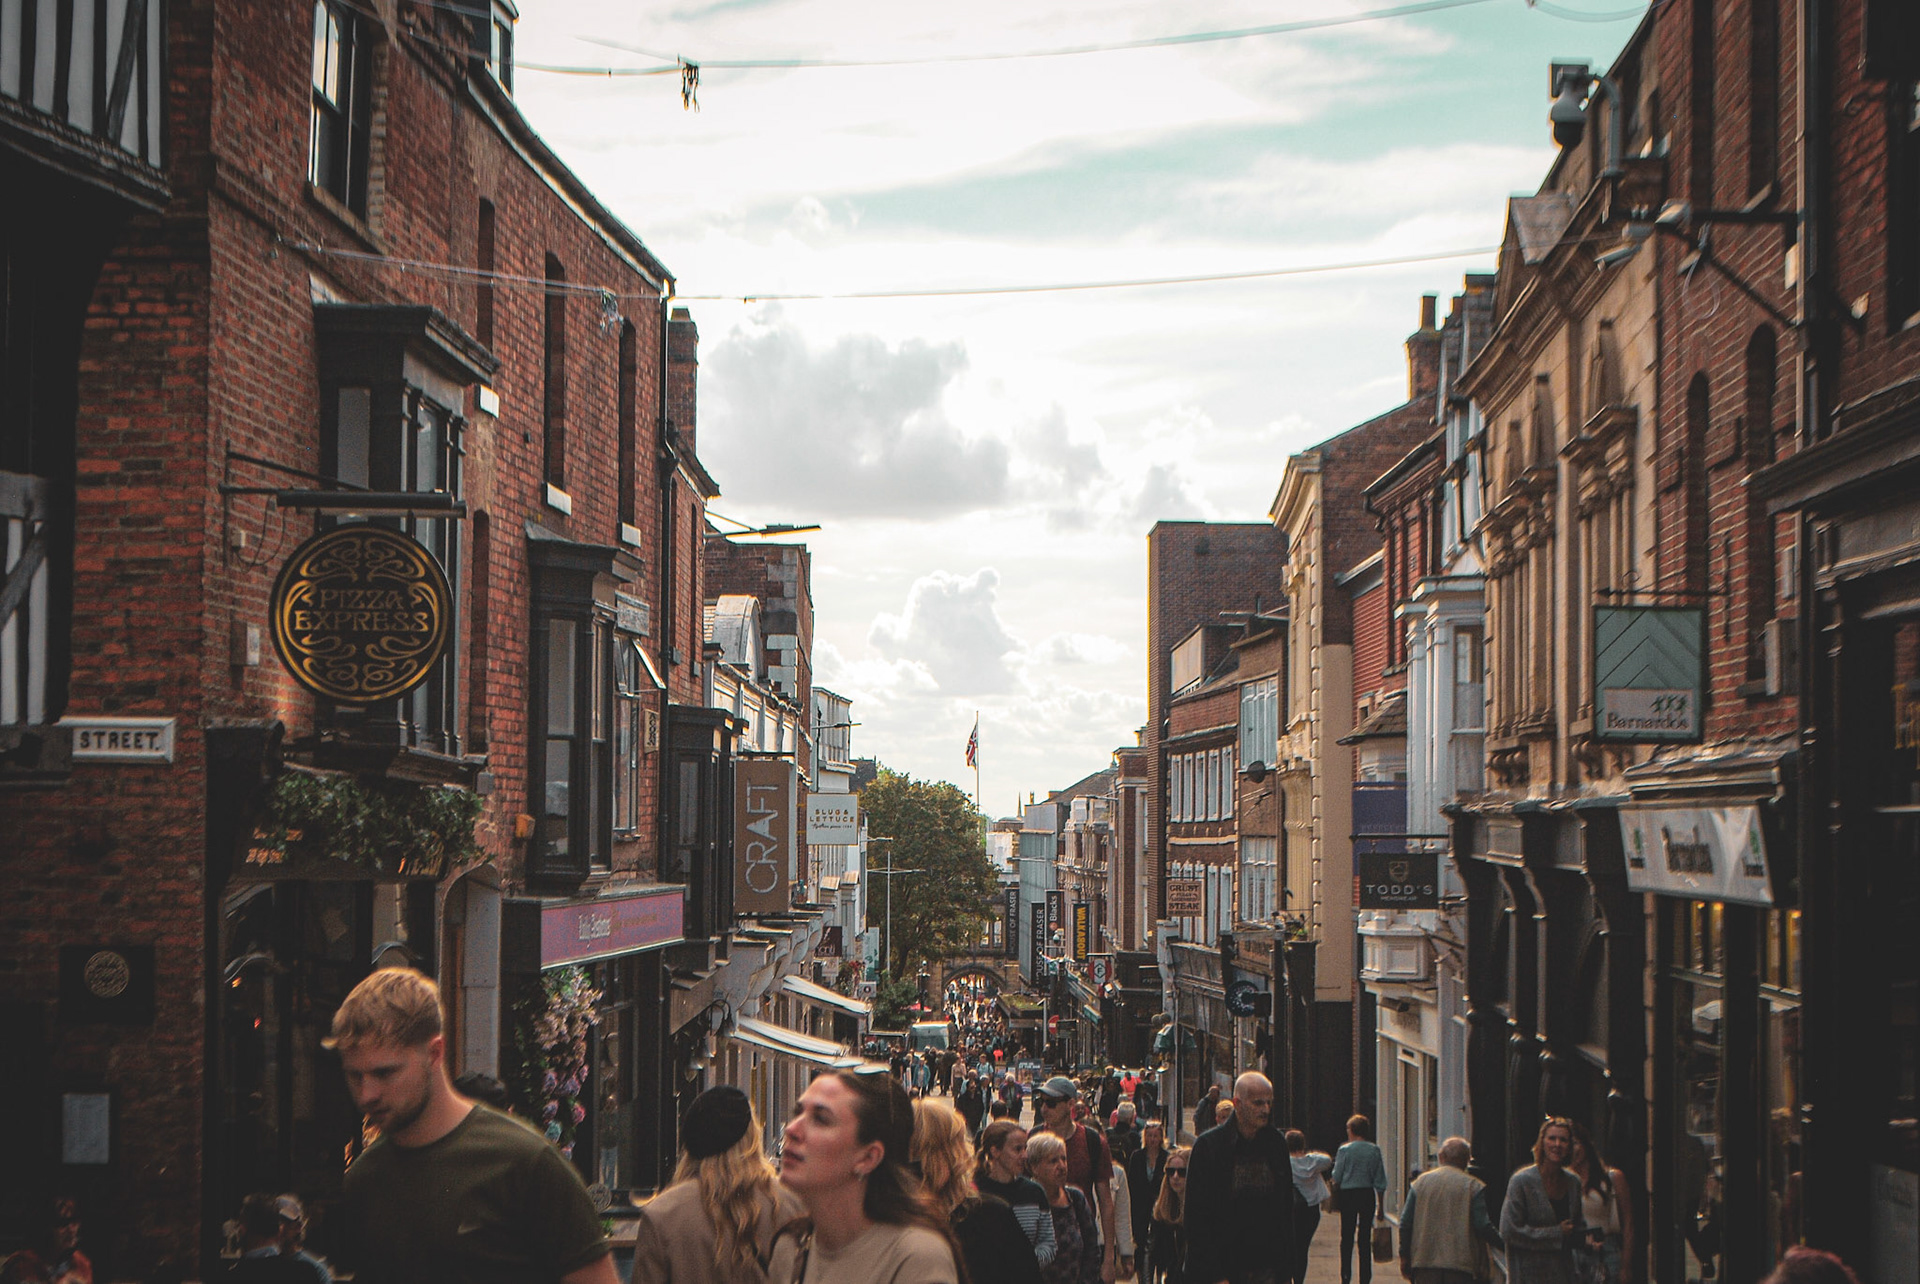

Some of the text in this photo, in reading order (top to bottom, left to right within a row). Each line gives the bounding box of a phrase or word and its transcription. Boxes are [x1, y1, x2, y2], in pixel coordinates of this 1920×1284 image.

[320, 589, 403, 609] PIZZA
[294, 610, 429, 632] EXPRESS
[745, 779, 778, 894] CRAFT
[1169, 884, 1199, 892] CRUST
[1366, 884, 1433, 895] TODD'S
[1050, 895, 1058, 922] Blacks
[1168, 902, 1200, 910] STEAK
[1010, 918, 1017, 929] OF
[1036, 909, 1044, 940] FRASER
[1077, 907, 1086, 960] WALKABOUT
[1036, 941, 1044, 954] OF
